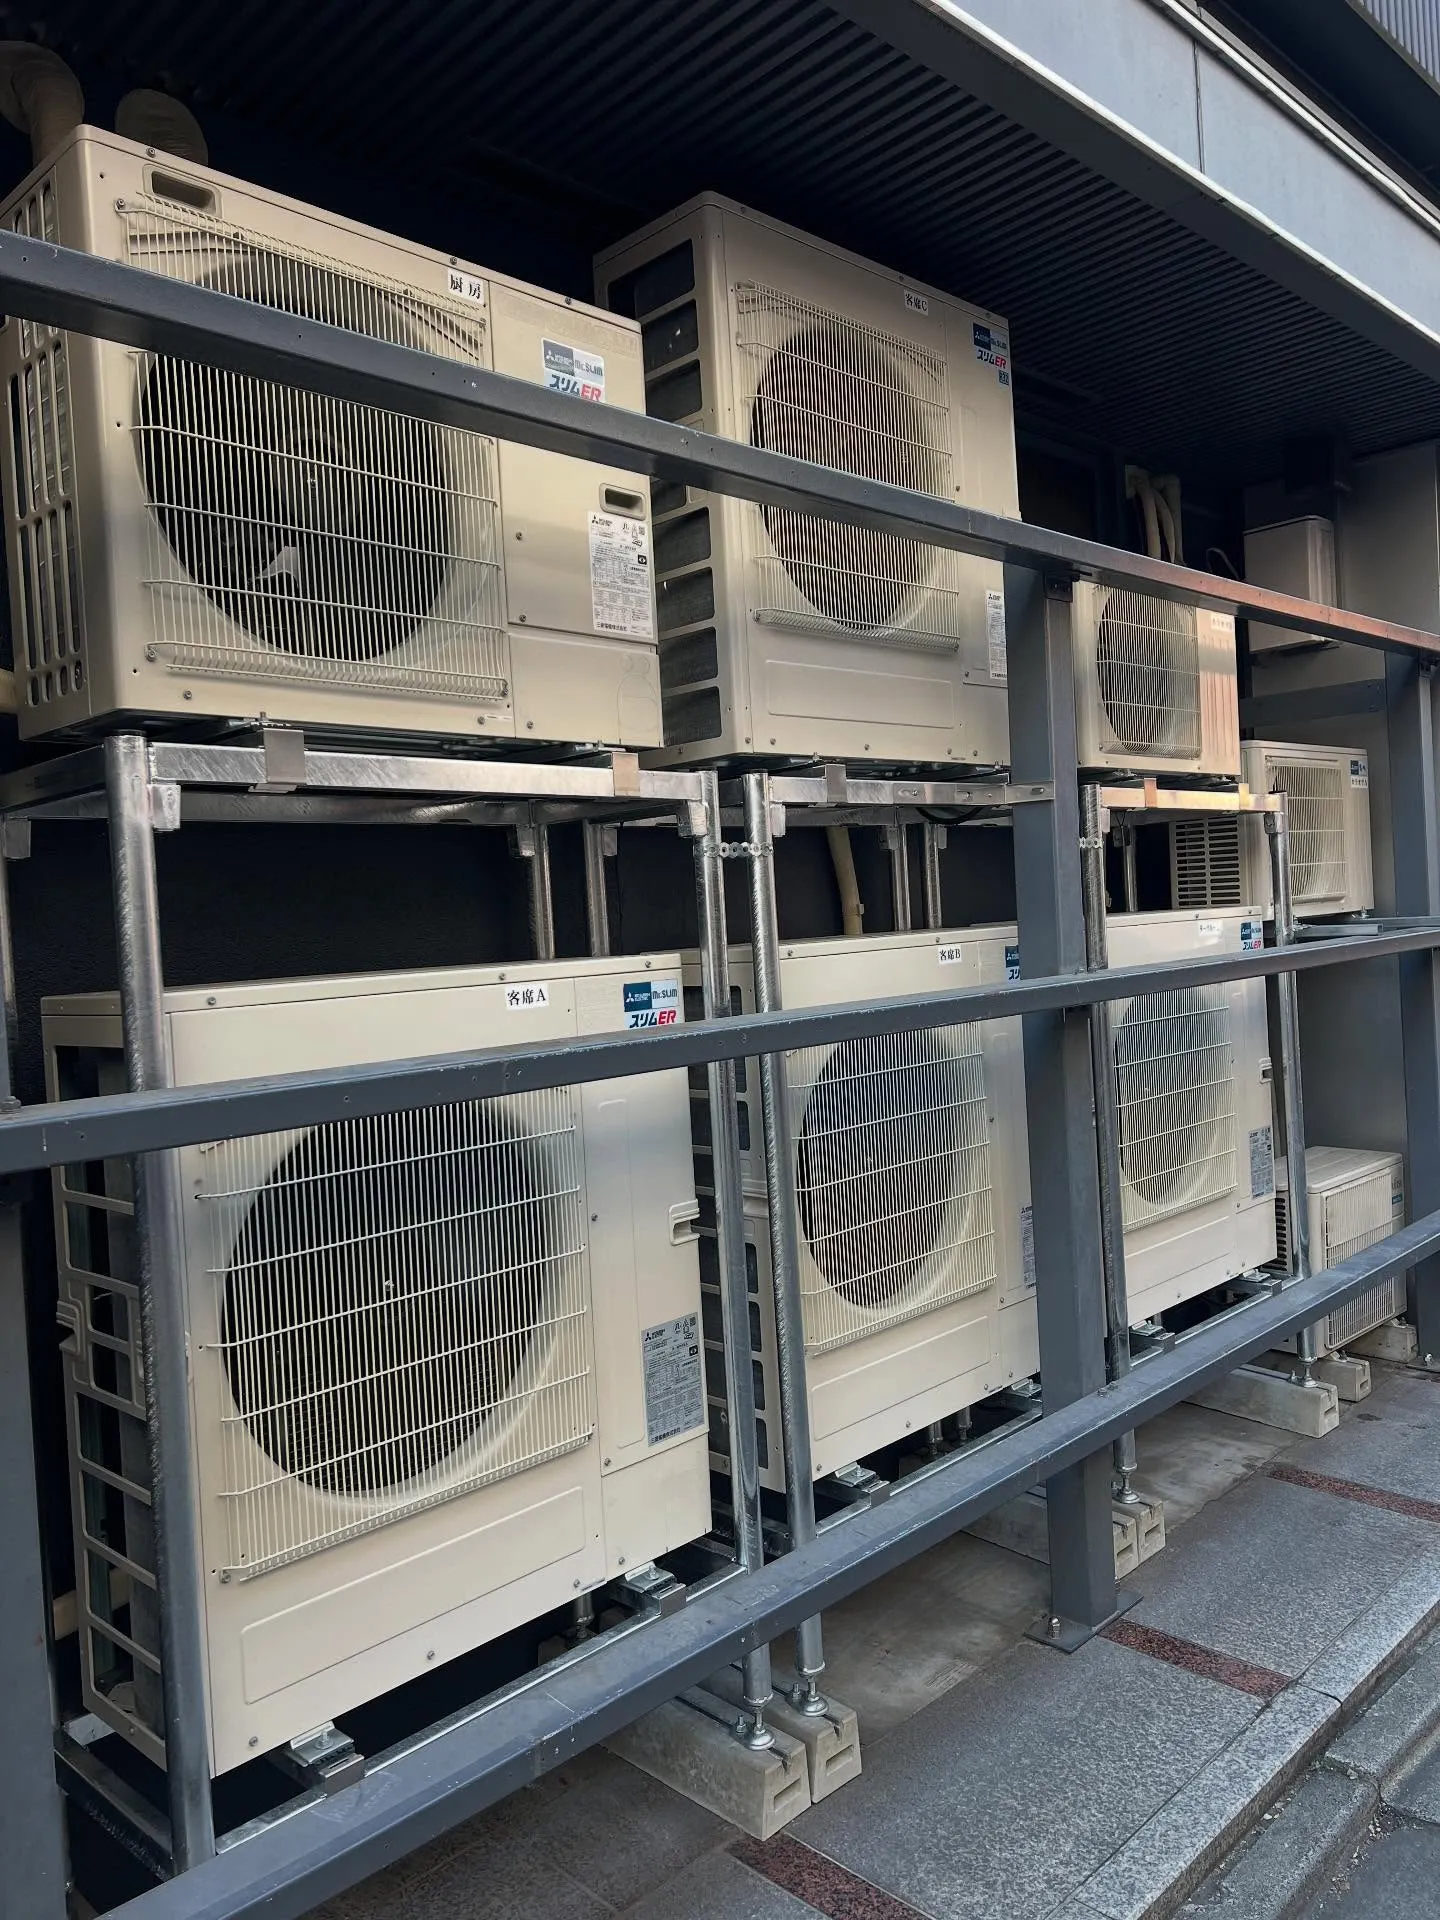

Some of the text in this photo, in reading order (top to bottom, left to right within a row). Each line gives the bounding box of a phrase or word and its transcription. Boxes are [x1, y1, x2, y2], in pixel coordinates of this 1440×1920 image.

[450, 274, 480, 299] 厨房
[905, 293, 928, 312] 客席C
[977, 349, 1006, 369] スリムER
[549, 374, 602, 402] スリムER
[939, 948, 961, 961] 客席B
[507, 988, 546, 1006] 客席A
[629, 1009, 677, 1029] スリムER
